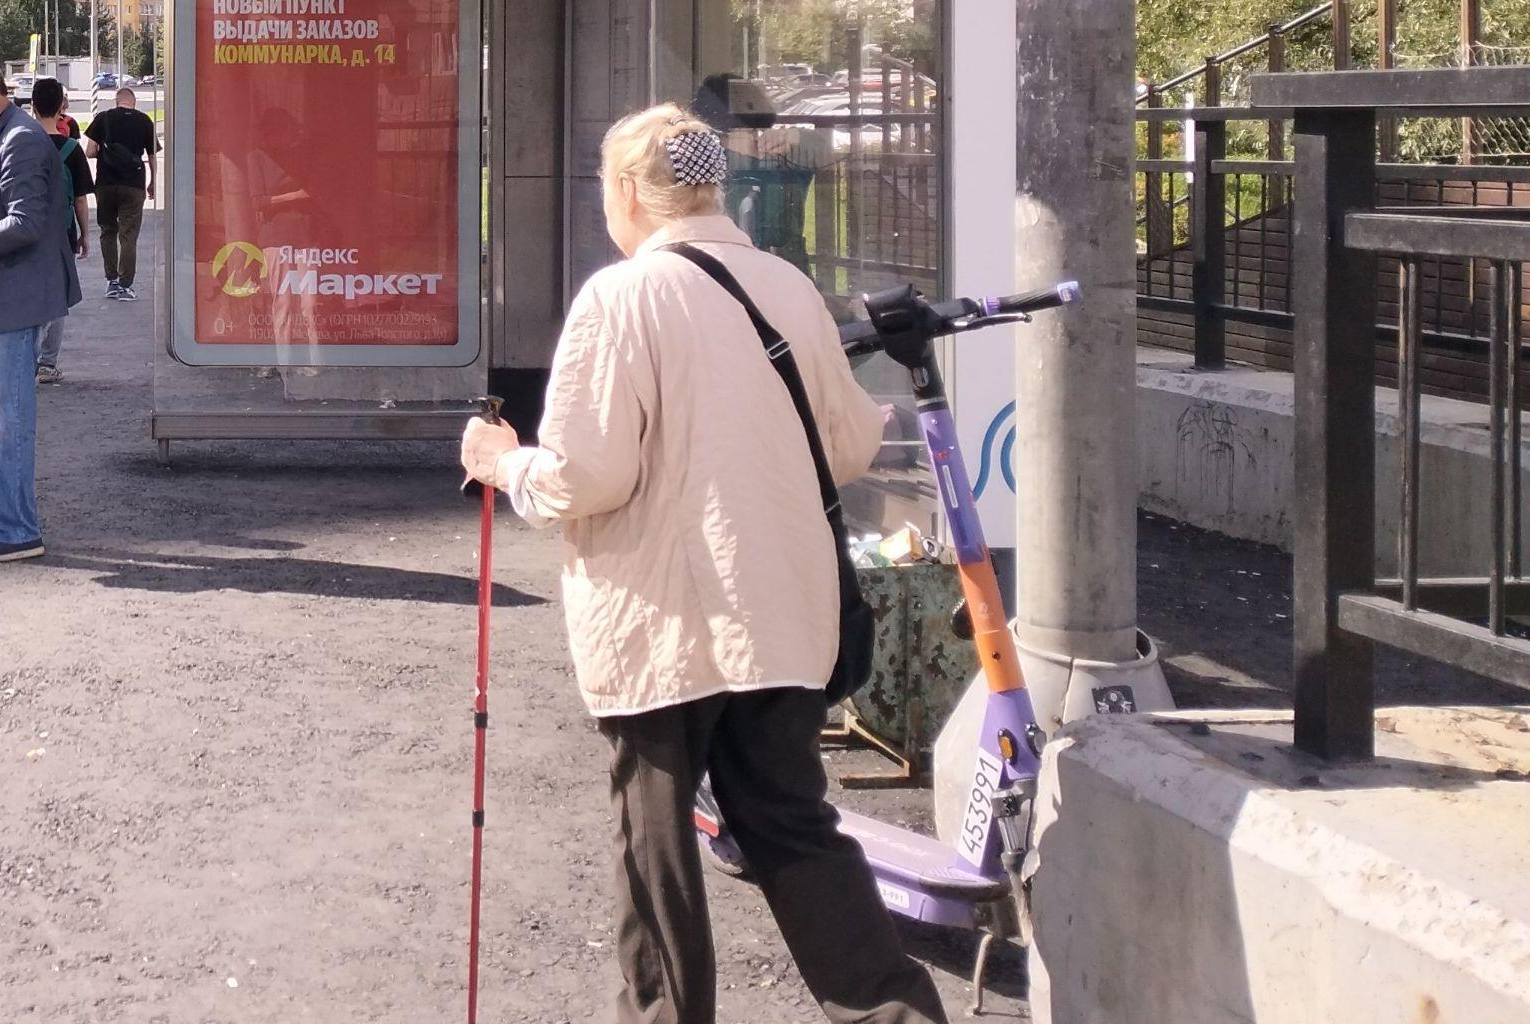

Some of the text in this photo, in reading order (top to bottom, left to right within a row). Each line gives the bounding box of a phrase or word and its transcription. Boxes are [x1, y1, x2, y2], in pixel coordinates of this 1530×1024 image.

[213, 19, 379, 43] ВЫДАЧИ ЗАКАЗОВ
[214, 44, 396, 67] КОММУНАРКА, д. 14
[279, 245, 359, 267] Яндекс
[962, 756, 999, 855] 453991
